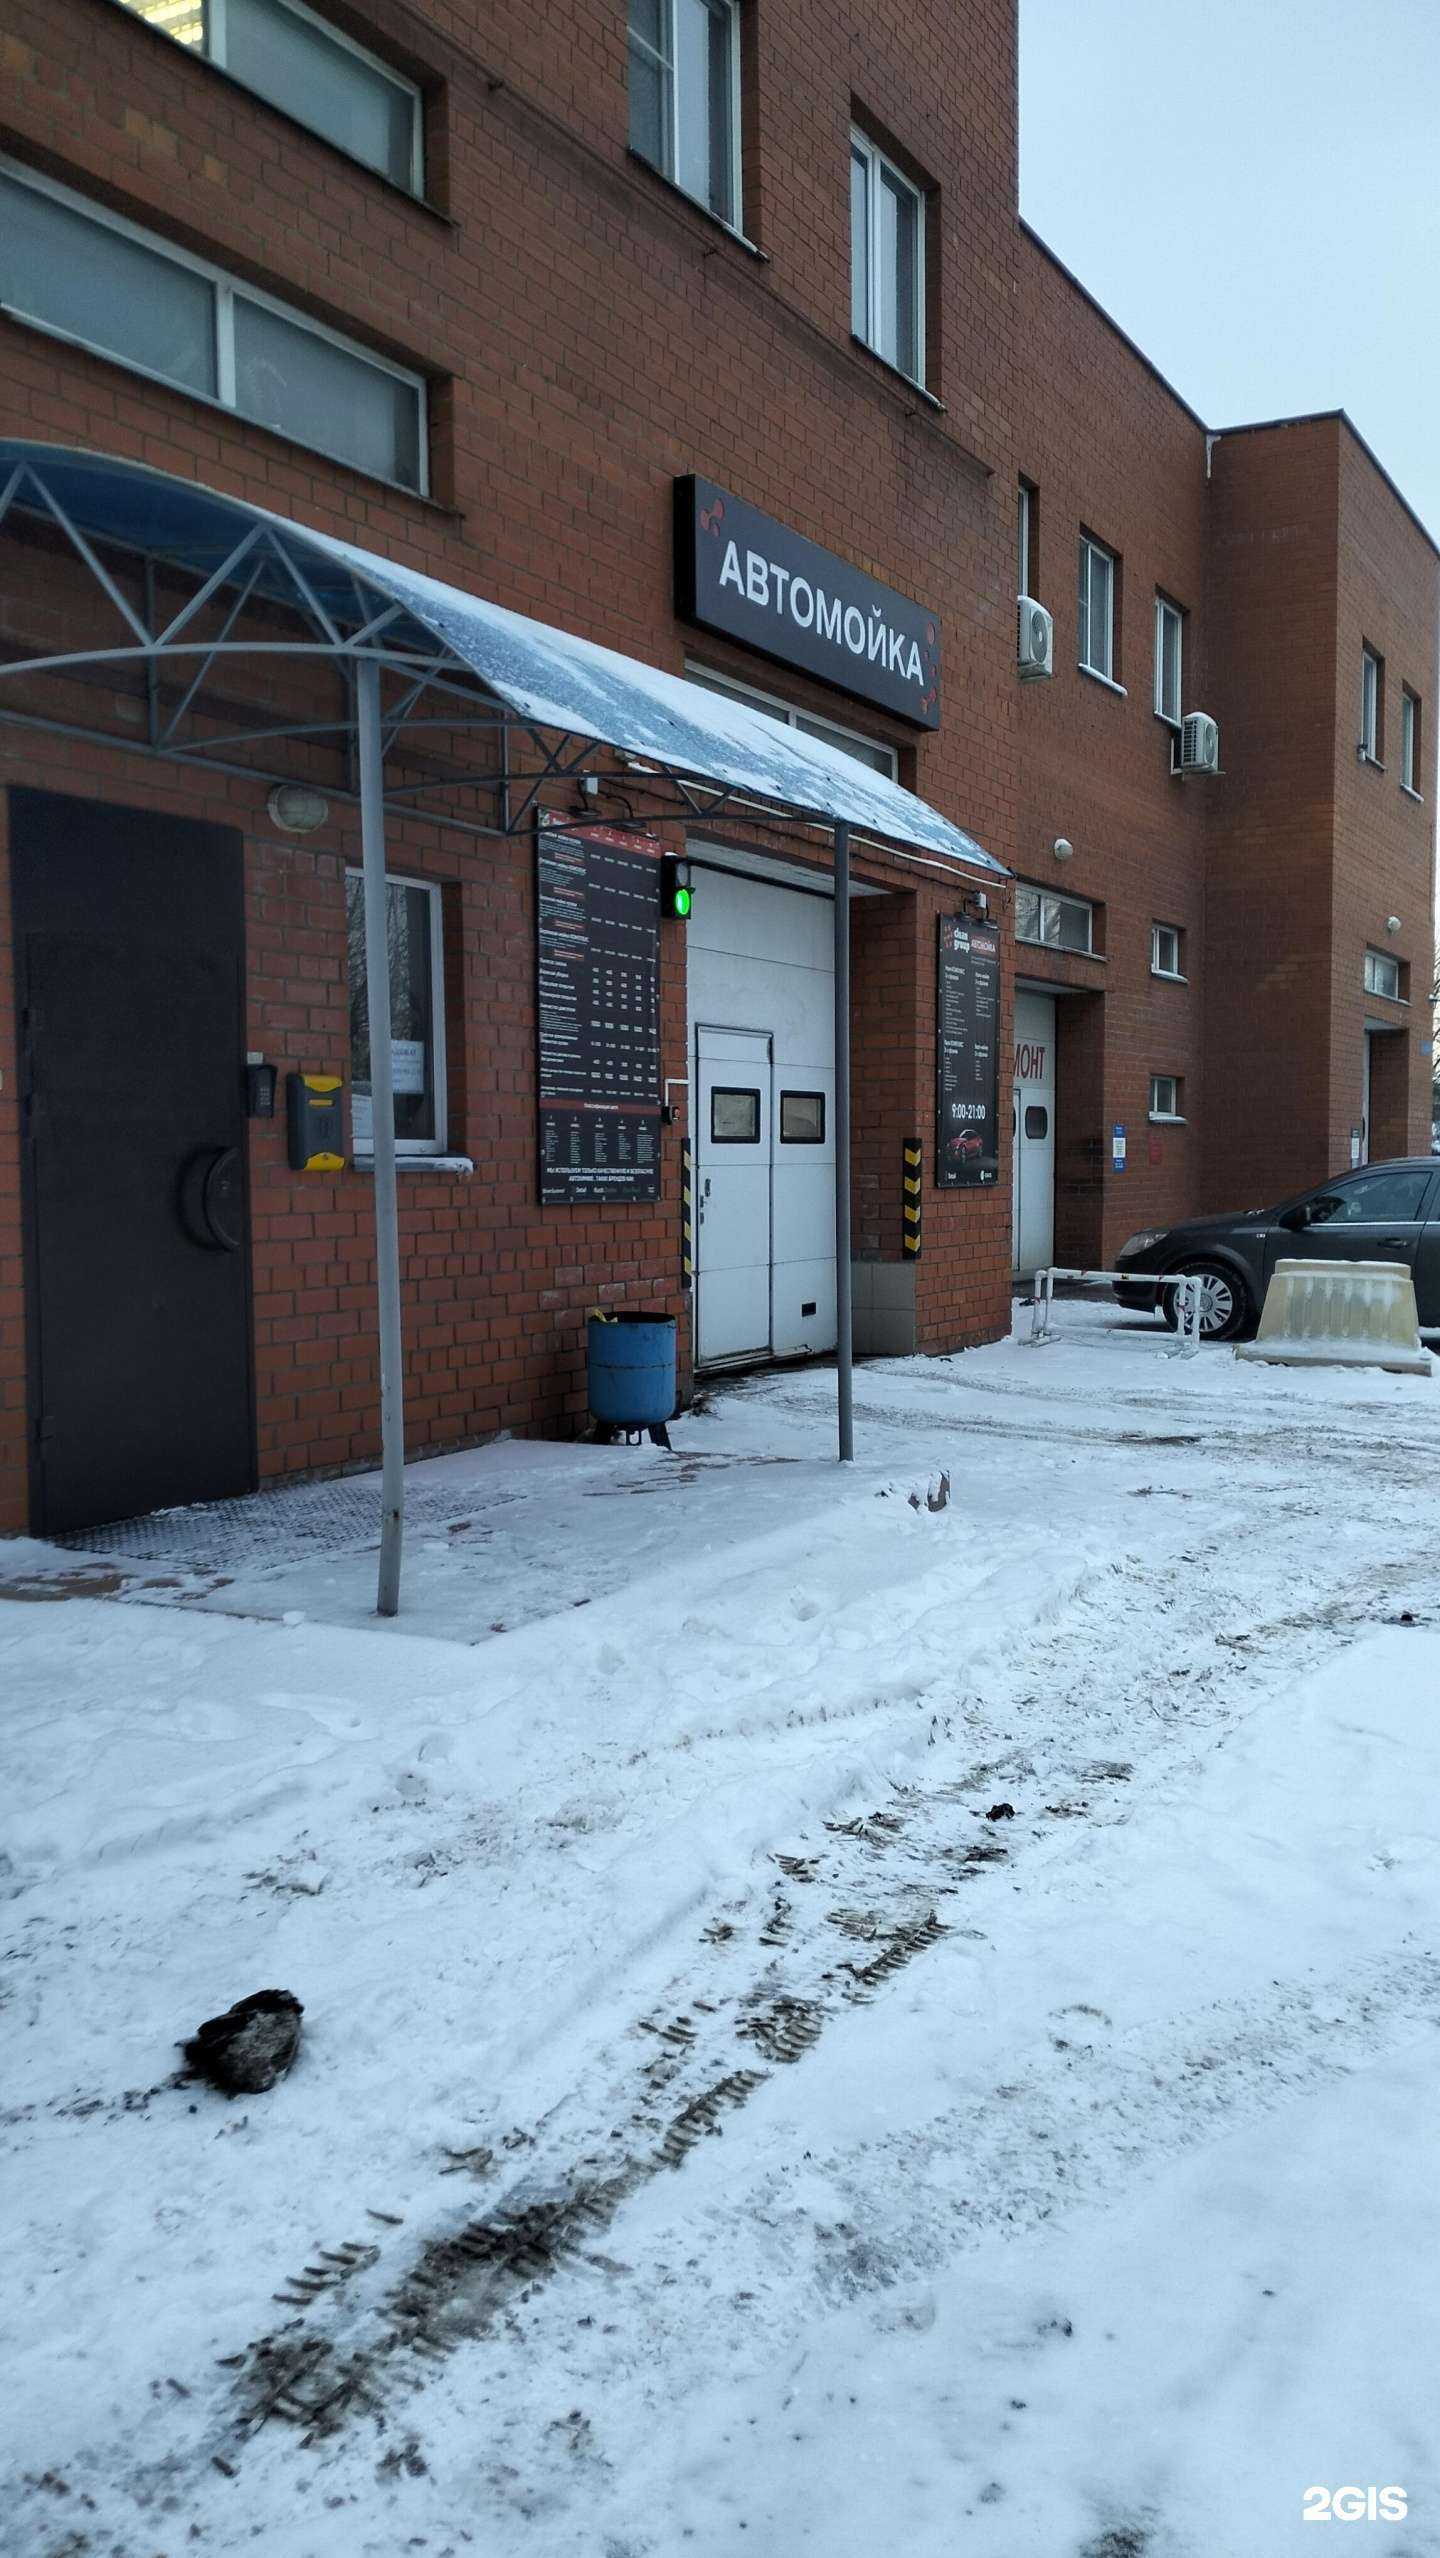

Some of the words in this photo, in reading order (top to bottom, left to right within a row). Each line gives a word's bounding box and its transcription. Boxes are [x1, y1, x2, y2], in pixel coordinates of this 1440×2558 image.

[719, 540, 924, 686] АВТОМОЙКА
[954, 939, 970, 953] group
[952, 1103, 986, 1119] 9:00-21:00
